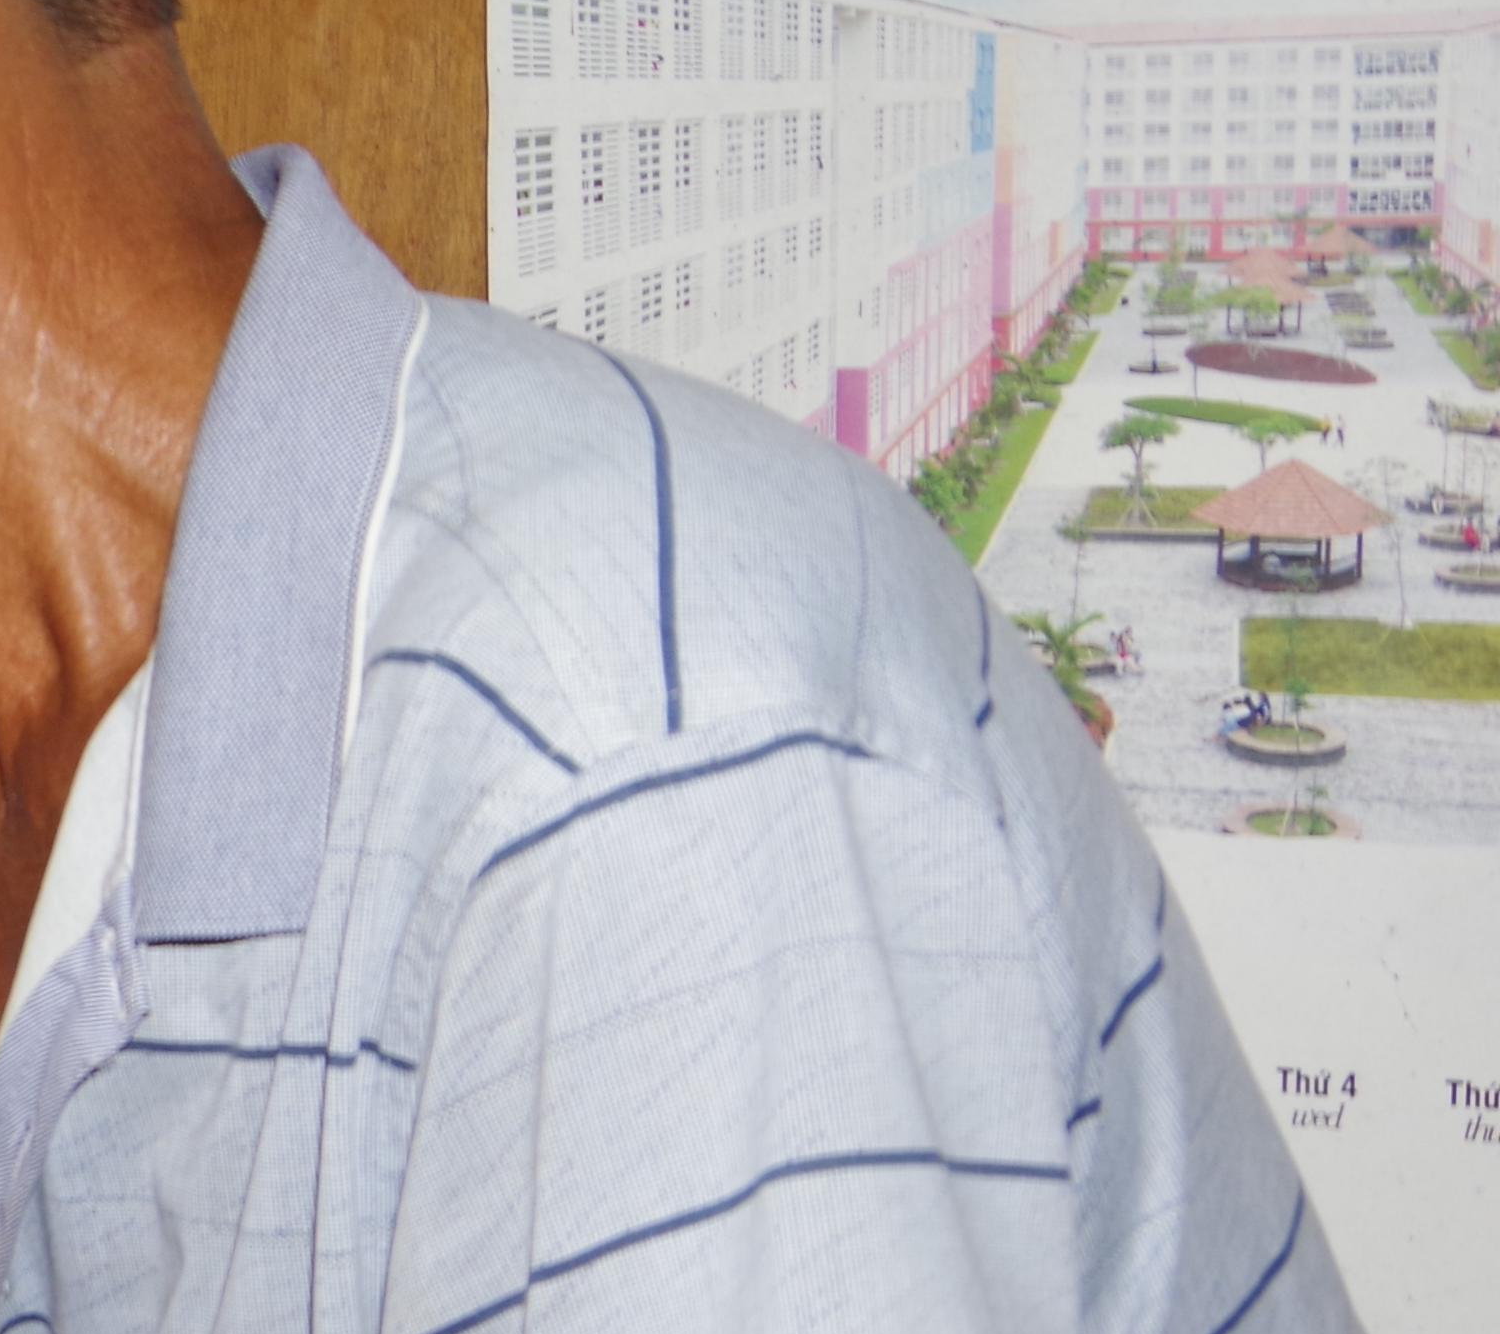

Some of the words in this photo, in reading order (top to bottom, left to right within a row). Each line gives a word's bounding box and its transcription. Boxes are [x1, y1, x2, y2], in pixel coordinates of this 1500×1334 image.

[1277, 1067, 1331, 1097] Thứ
[1341, 1073, 1357, 1098] 4
[1291, 1102, 1345, 1130] wed
